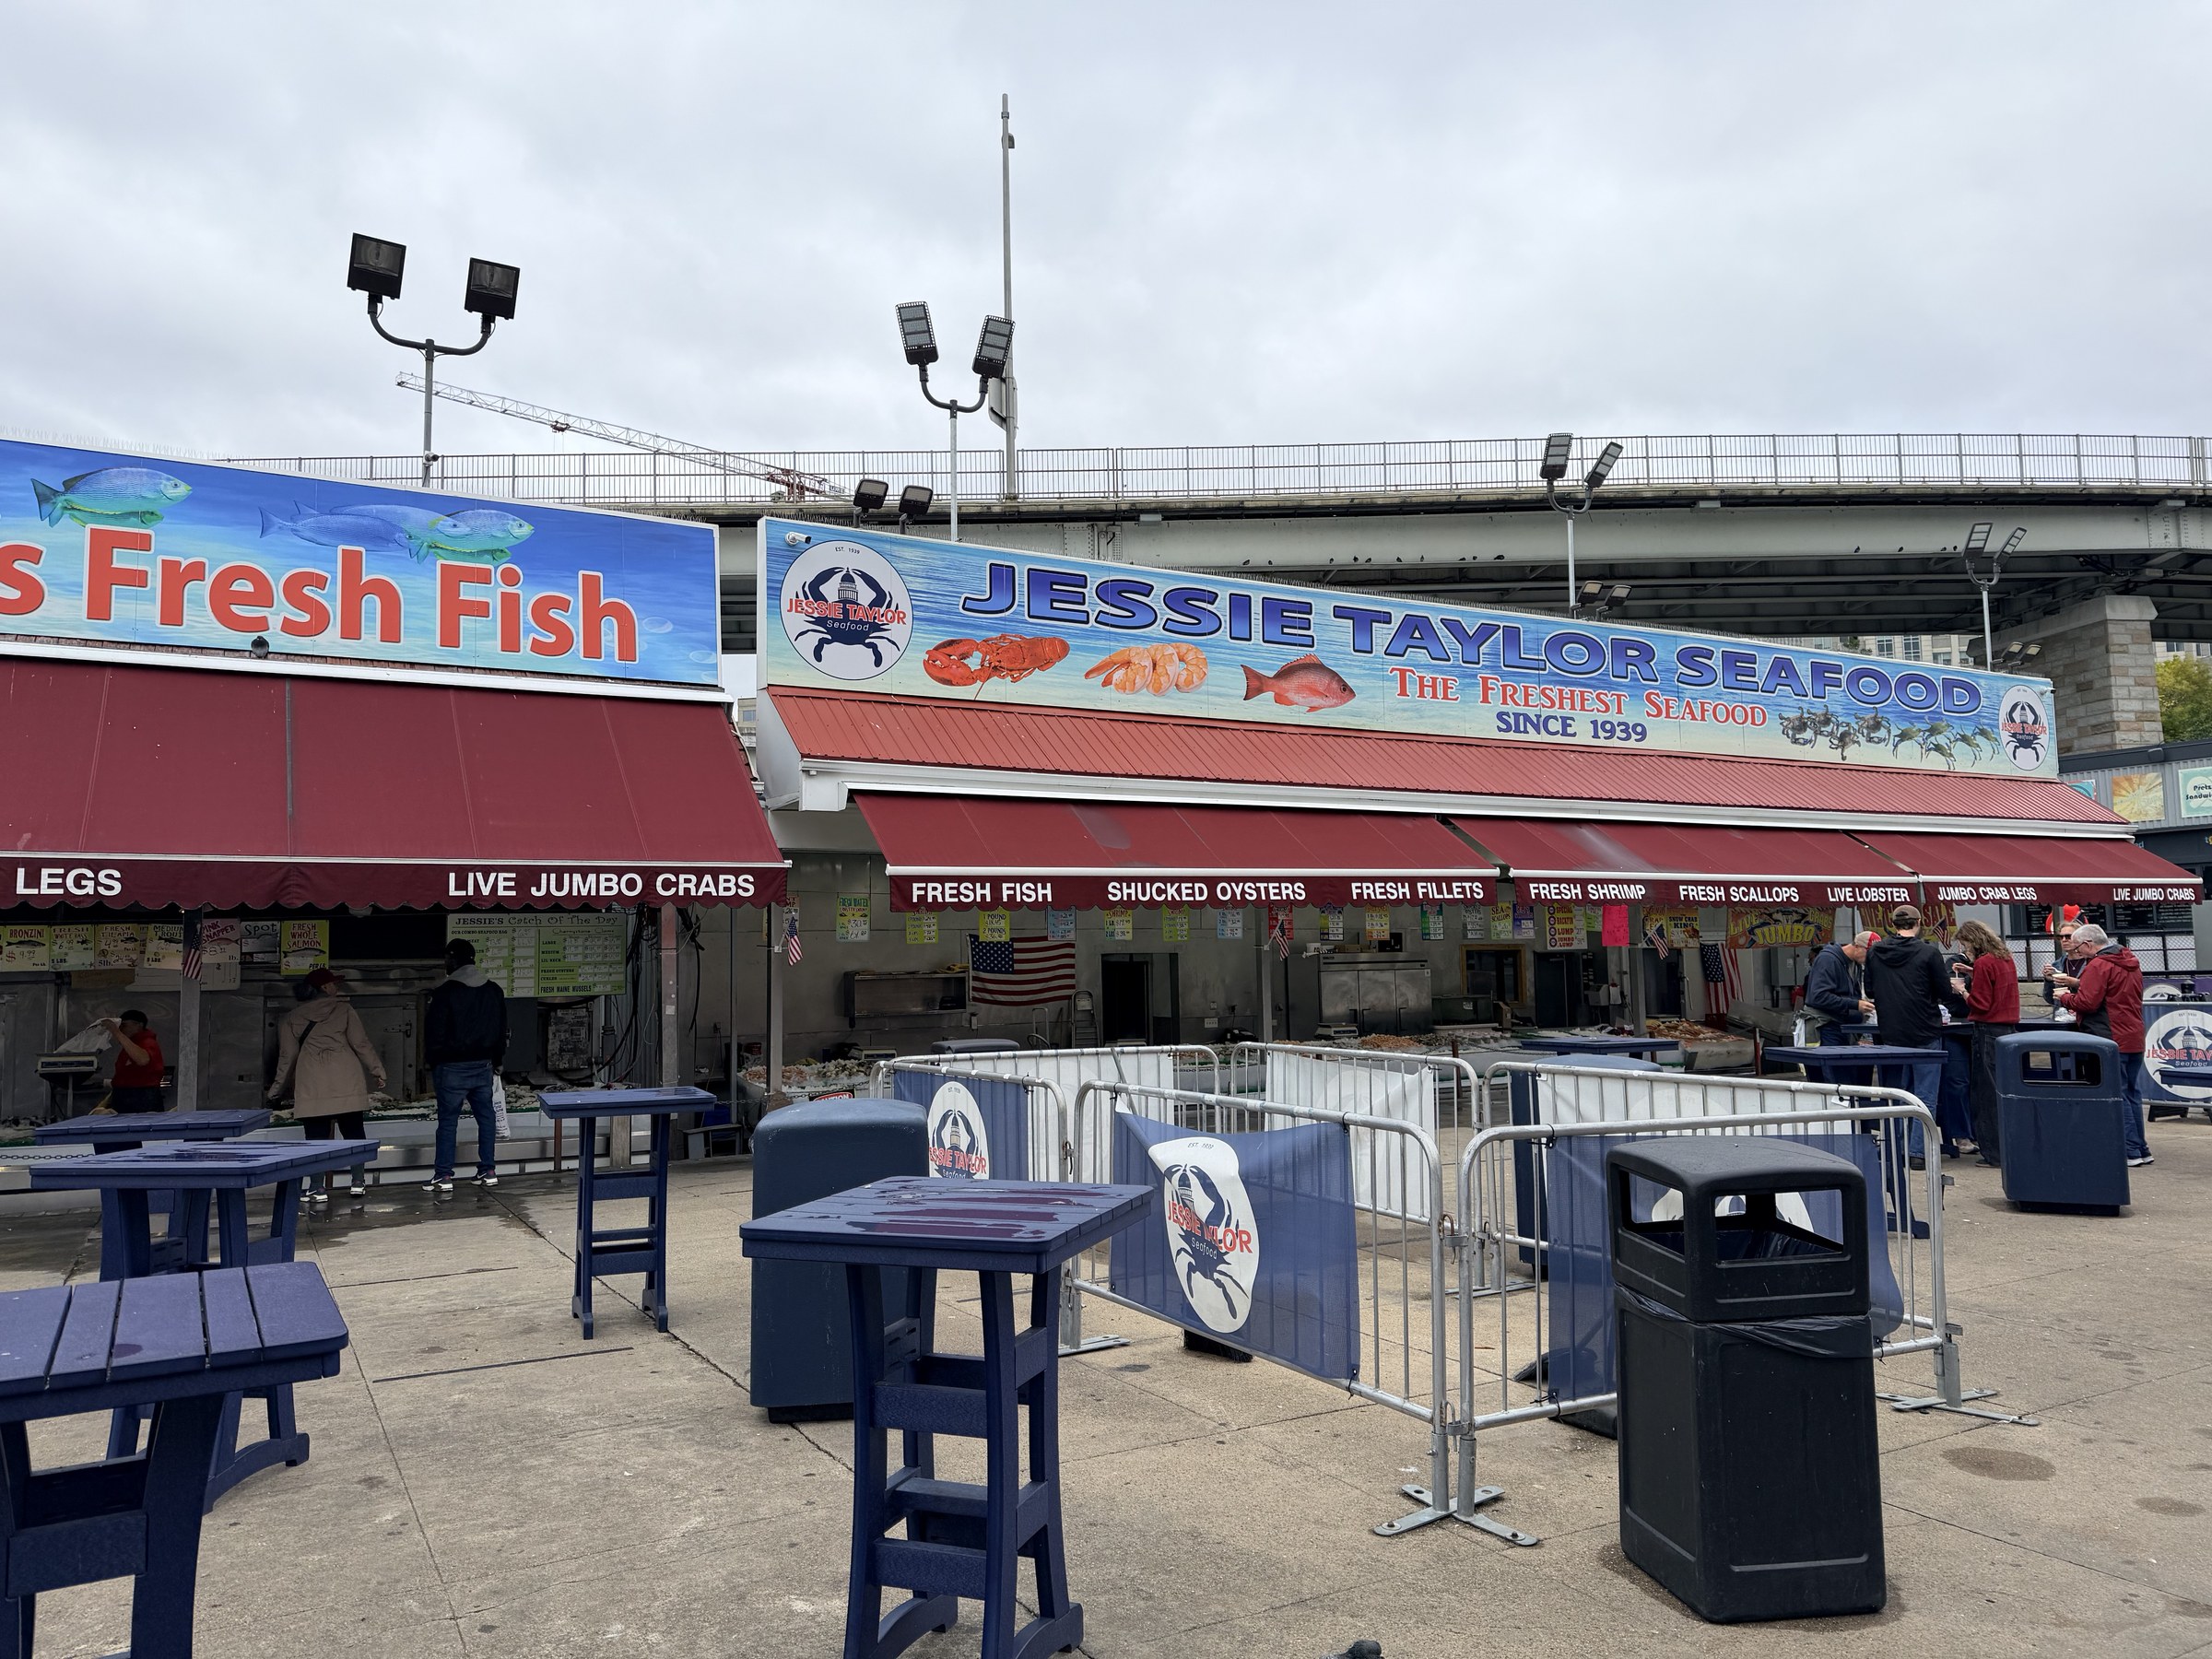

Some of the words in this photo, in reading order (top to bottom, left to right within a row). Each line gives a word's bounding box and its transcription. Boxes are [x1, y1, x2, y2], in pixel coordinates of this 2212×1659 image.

[86, 526, 402, 644] Fresh
[436, 559, 639, 663] Fish
[787, 598, 843, 620] JESSIE
[846, 605, 907, 626] TAYLOR
[826, 619, 870, 631] Seafood
[960, 561, 1315, 649] JESSIE
[1332, 604, 1660, 683] TAYLOR
[1676, 645, 1983, 715] SEAFOOD
[1389, 667, 1460, 701] THE
[1478, 676, 1629, 715] FRESHEST
[1645, 690, 1769, 727] SEAFOOD
[1496, 712, 1576, 737] SINCE
[1590, 719, 1647, 742] 1939
[2002, 723, 2022, 733] JESSIE
[17, 867, 122, 896] LEGS
[448, 872, 517, 896] LIVE
[531, 873, 643, 897] JUMBO
[656, 873, 755, 898] CRABS
[1107, 881, 1208, 901] SHUCKED
[1216, 882, 1306, 901] OYSTERS
[1351, 881, 1411, 900] FRESH
[1417, 881, 1484, 900] FILLETS
[912, 882, 992, 903] FRESH
[1002, 882, 1053, 903] FISH
[1528, 883, 1583, 900] FRESH
[1587, 883, 1646, 900] SHRIMP
[1678, 885, 1726, 901] FRESH
[1730, 886, 1800, 902] SCALLOPS
[1827, 887, 1853, 902] LIVE
[1855, 887, 1911, 902] LOBSTER
[1937, 886, 1976, 901] JUMBO
[1979, 887, 2010, 900] CRAB
[2011, 887, 2038, 900] LEGS
[2113, 888, 2131, 901] LIVE
[2133, 888, 2164, 901] JUMBO
[2167, 888, 2195, 901] CRABS
[455, 917, 503, 925] JESSIE'S
[509, 915, 542, 925] Catch
[547, 915, 564, 924] Of
[568, 915, 590, 924] The
[595, 915, 618, 925] Day
[1491, 906, 1505, 915] SEA
[1808, 908, 1833, 930] CRABS
[244, 923, 277, 936] Spot
[292, 923, 316, 931] FRESH
[1729, 912, 1759, 935] LIVE
[9, 928, 44, 939] BRONZINI
[290, 931, 318, 939] WHOLE
[1756, 924, 1816, 945] JUMBO
[287, 939, 322, 949] SALMON
[2146, 1049, 2188, 1059] JESSIE
[929, 1147, 953, 1168] ESSIE
[955, 1150, 987, 1174] TAYLOR
[1168, 1200, 1202, 1236] JESSIE
[1191, 1237, 1218, 1260] Seafood
